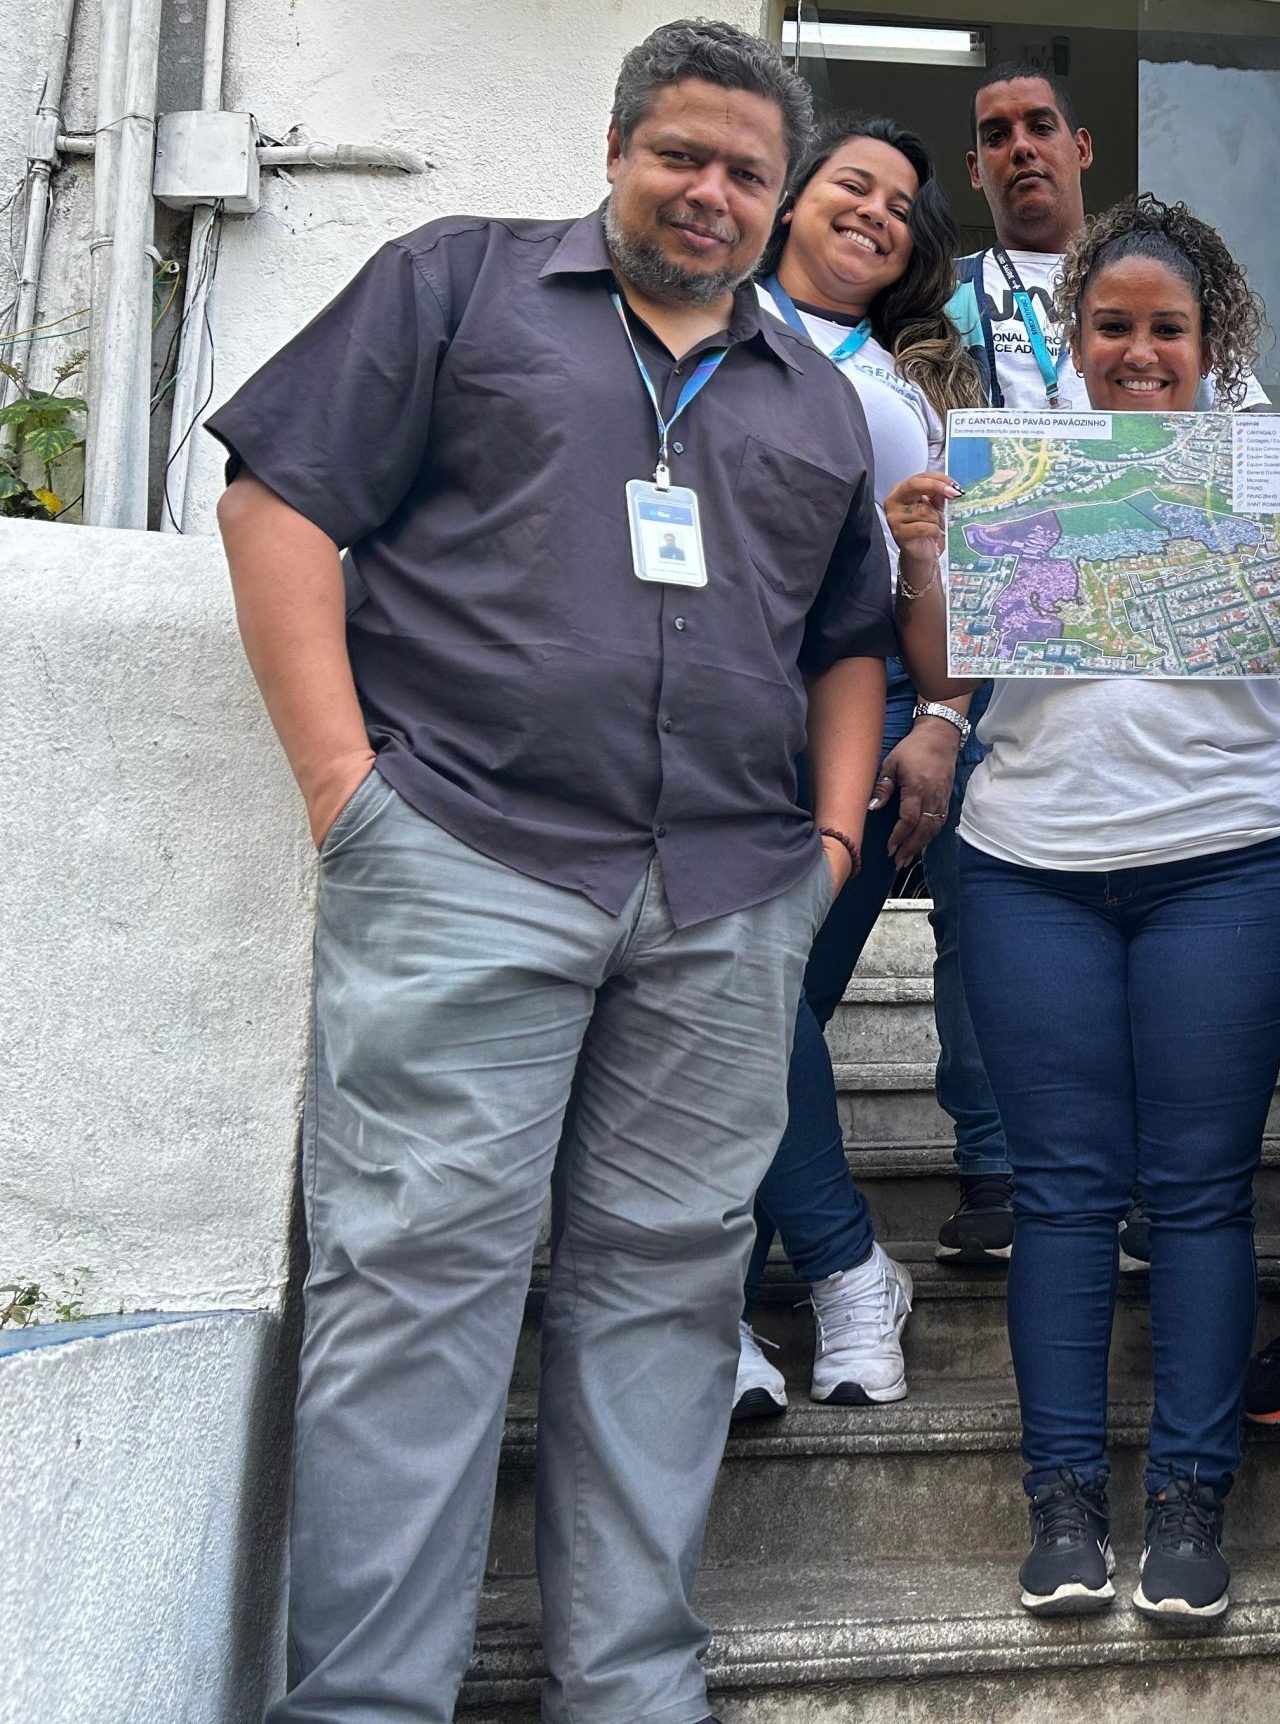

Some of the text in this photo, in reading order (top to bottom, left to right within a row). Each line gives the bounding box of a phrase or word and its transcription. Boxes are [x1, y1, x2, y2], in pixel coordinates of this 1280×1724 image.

[968, 417, 1021, 425] CANTAGALO
[1022, 417, 1051, 426] PAVÃO
[1052, 417, 1106, 427] PAVÃOZINHO
